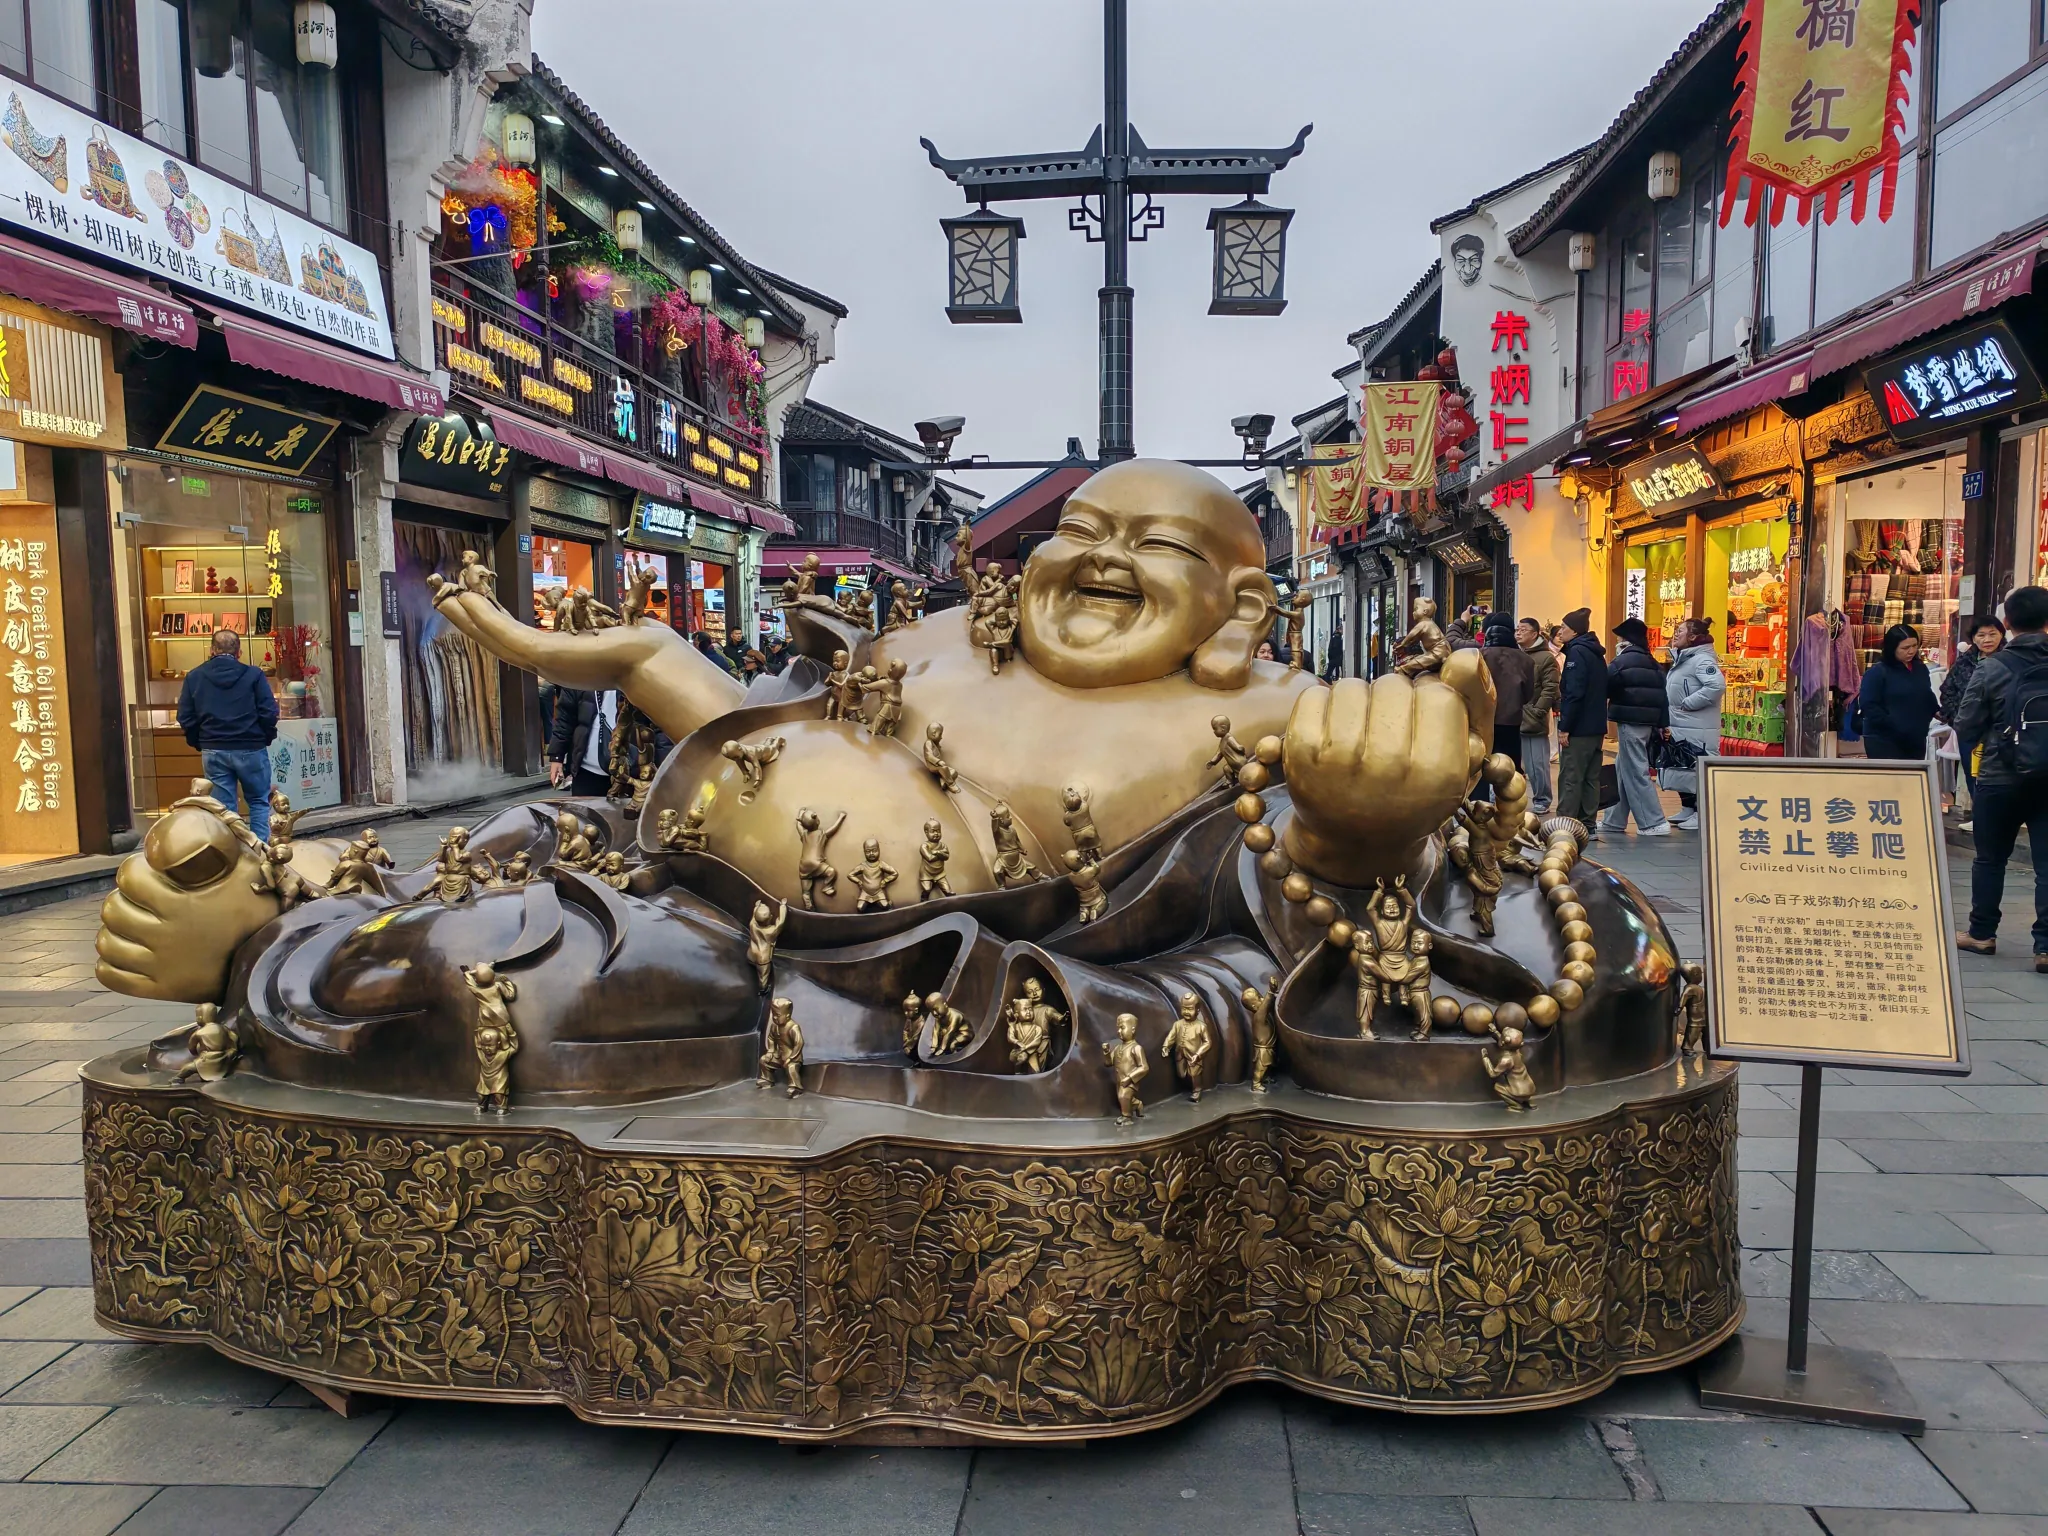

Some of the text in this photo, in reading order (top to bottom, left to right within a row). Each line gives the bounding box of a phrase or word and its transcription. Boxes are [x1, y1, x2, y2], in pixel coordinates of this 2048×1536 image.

[298, 20, 335, 39] 清河坊
[1987, 258, 2027, 291] 清河坊
[143, 306, 185, 331] 清河坊
[1904, 337, 2018, 411] 梦雪丝绸
[1941, 403, 1964, 417] MENG
[1978, 391, 2000, 407] SILK
[22, 409, 103, 438] 国家级非物质文化遗产
[1382, 388, 1420, 482] 江南銅屋
[417, 421, 511, 477] 遇见白娘子
[1965, 482, 1979, 497] 217
[1789, 544, 1799, 555] 215
[0, 538, 43, 813] 树皮创意集合店
[27, 541, 61, 809] Bark Creative Collection Store
[316, 731, 333, 746] 首款
[300, 746, 333, 763] 门店限定
[301, 760, 333, 779] 套色印章
[1737, 795, 1903, 826] 文明参观
[1738, 827, 1906, 861] 禁止攀爬
[1740, 862, 1908, 879] Civilized Visit No Climbing
[1774, 892, 1876, 909] 百子戏弥勒介绍
